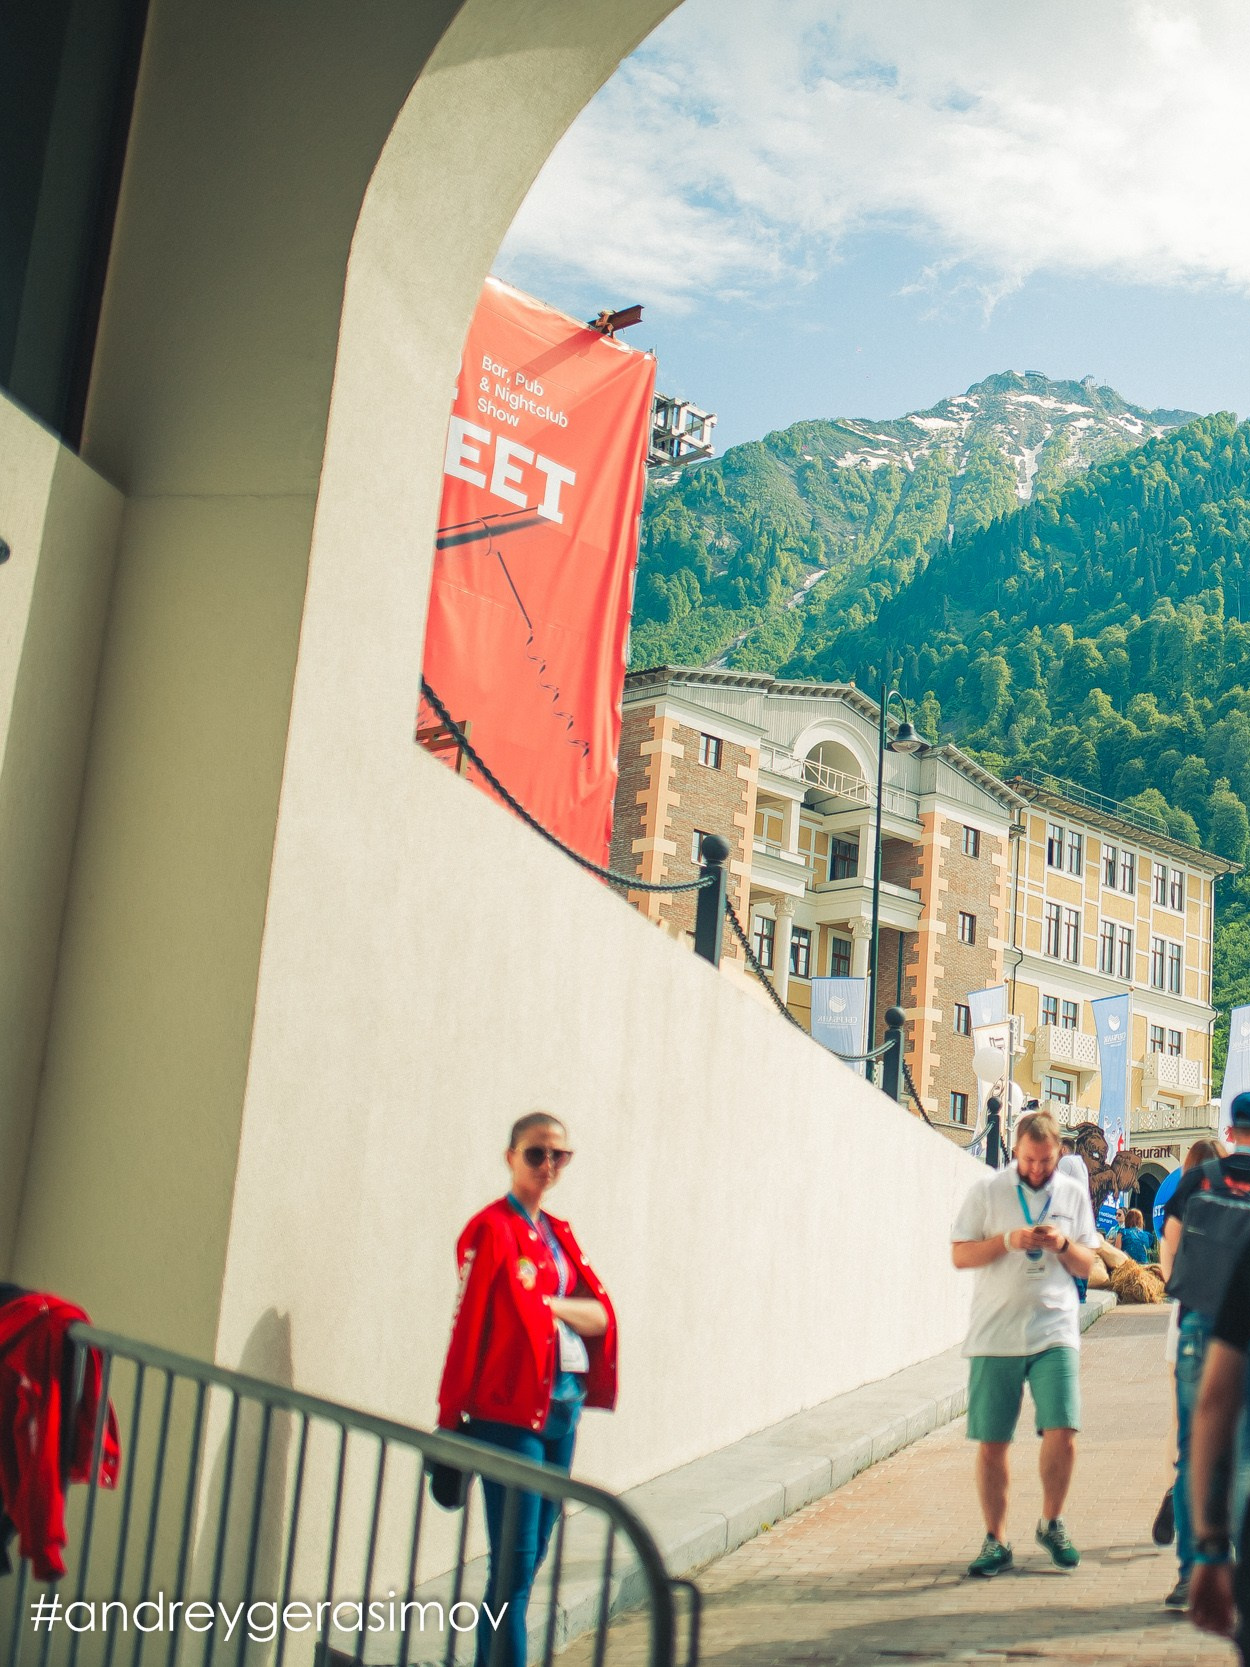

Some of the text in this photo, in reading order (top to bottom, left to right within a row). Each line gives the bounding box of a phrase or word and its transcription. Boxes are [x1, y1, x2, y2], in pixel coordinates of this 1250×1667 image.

[482, 355, 544, 397] Bar, Pub
[477, 397, 520, 427] Show
[480, 376, 568, 428] & Nightclub
[444, 415, 576, 524] EET
[1131, 1145, 1171, 1159] taurant
